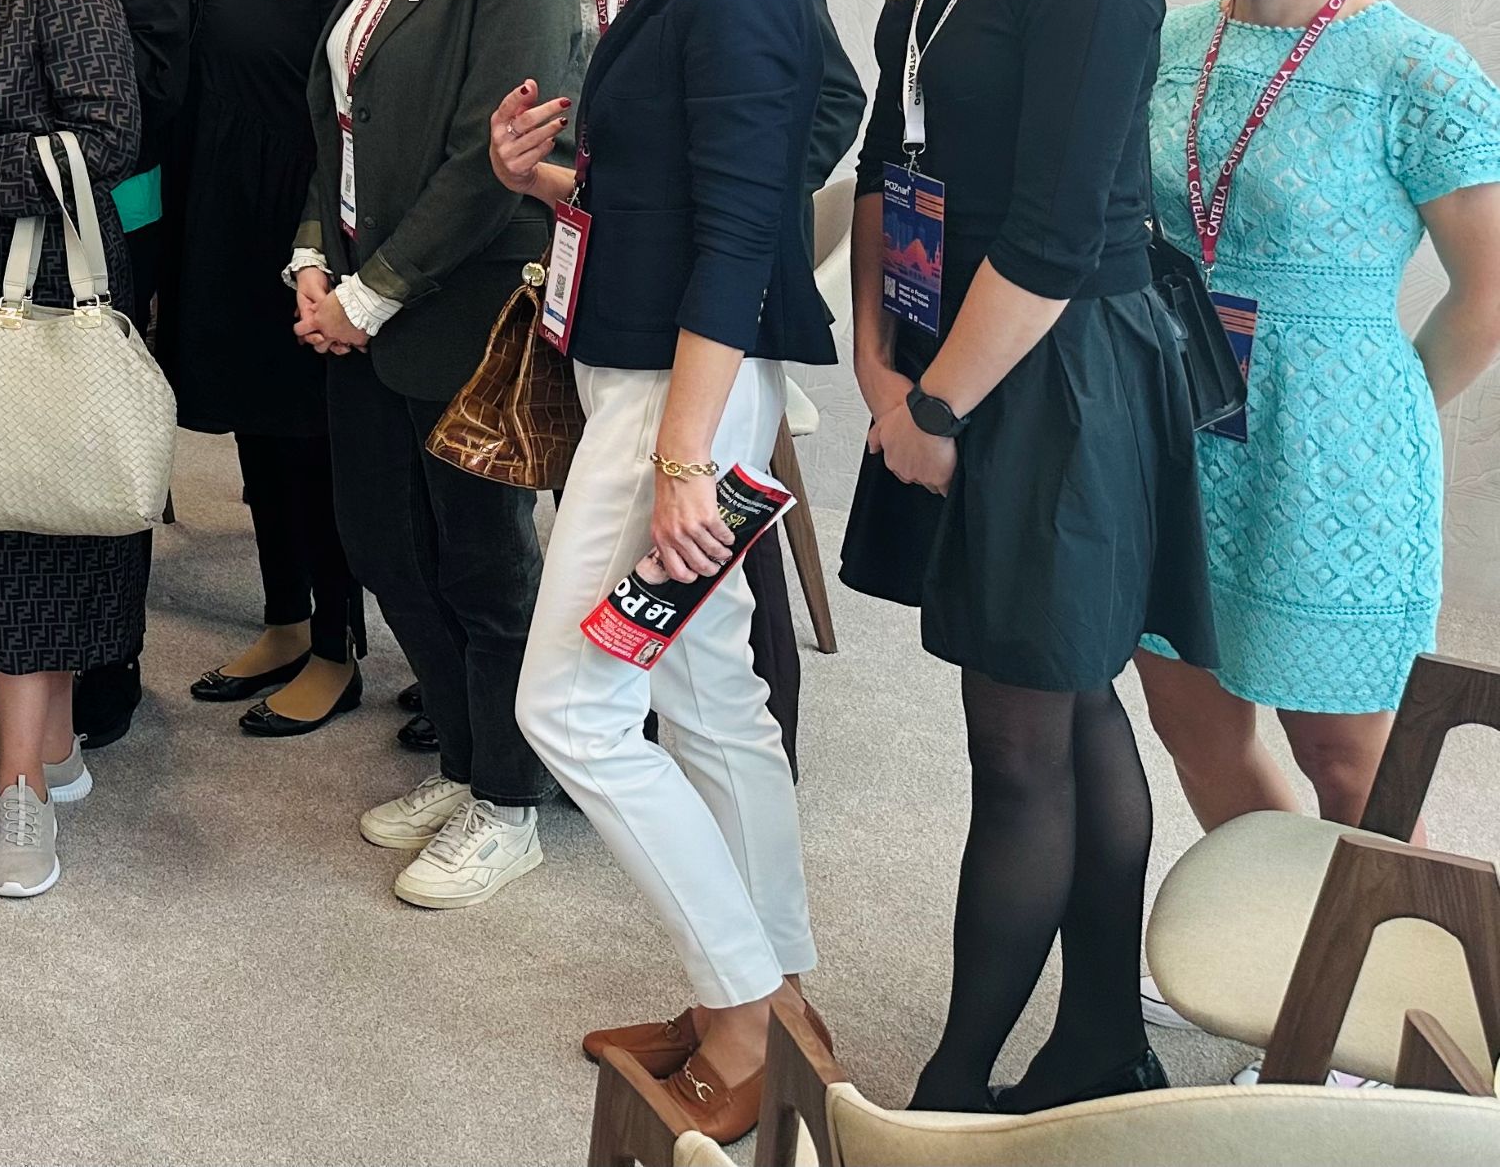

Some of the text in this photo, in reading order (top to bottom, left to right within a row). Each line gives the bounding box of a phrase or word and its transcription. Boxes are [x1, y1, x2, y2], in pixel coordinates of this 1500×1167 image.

[1290, 16, 1331, 63] CATELLA
[1255, 70, 1293, 119] CATELLA
[1222, 126, 1256, 176] CATELLA
[1189, 179, 1208, 237] CATELLA
[1206, 185, 1228, 237] CATELLA
[645, 601, 678, 631] Le
